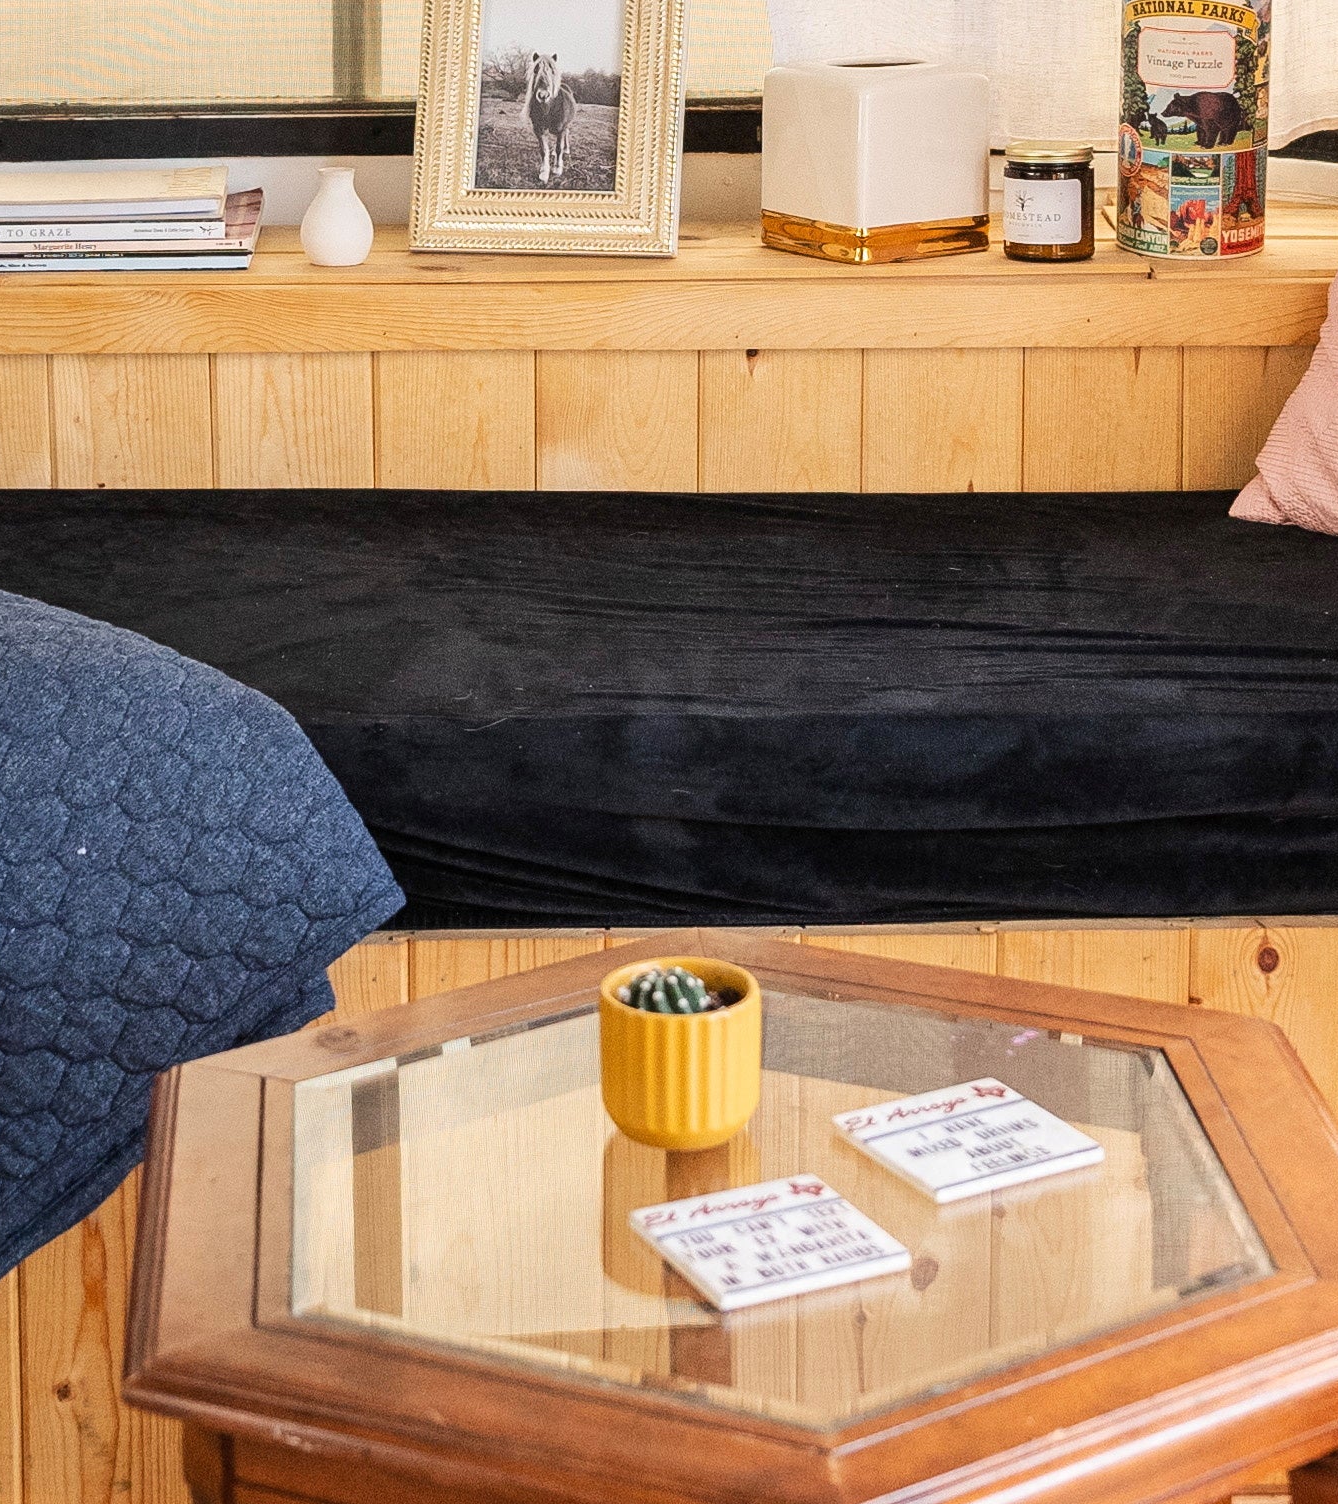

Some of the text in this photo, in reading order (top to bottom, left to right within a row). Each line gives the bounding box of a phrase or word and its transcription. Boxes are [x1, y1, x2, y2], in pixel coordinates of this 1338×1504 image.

[1132, 0, 1246, 23] NATIONAL PARKS
[1146, 55, 1223, 70] Vintage Puzzle
[7, 229, 24, 238] TO
[29, 228, 72, 238] GRAZE
[33, 242, 97, 252] Marguerite Henry
[844, 1095, 967, 1134] El Arroyo
[644, 1193, 779, 1229] El Arroyo
